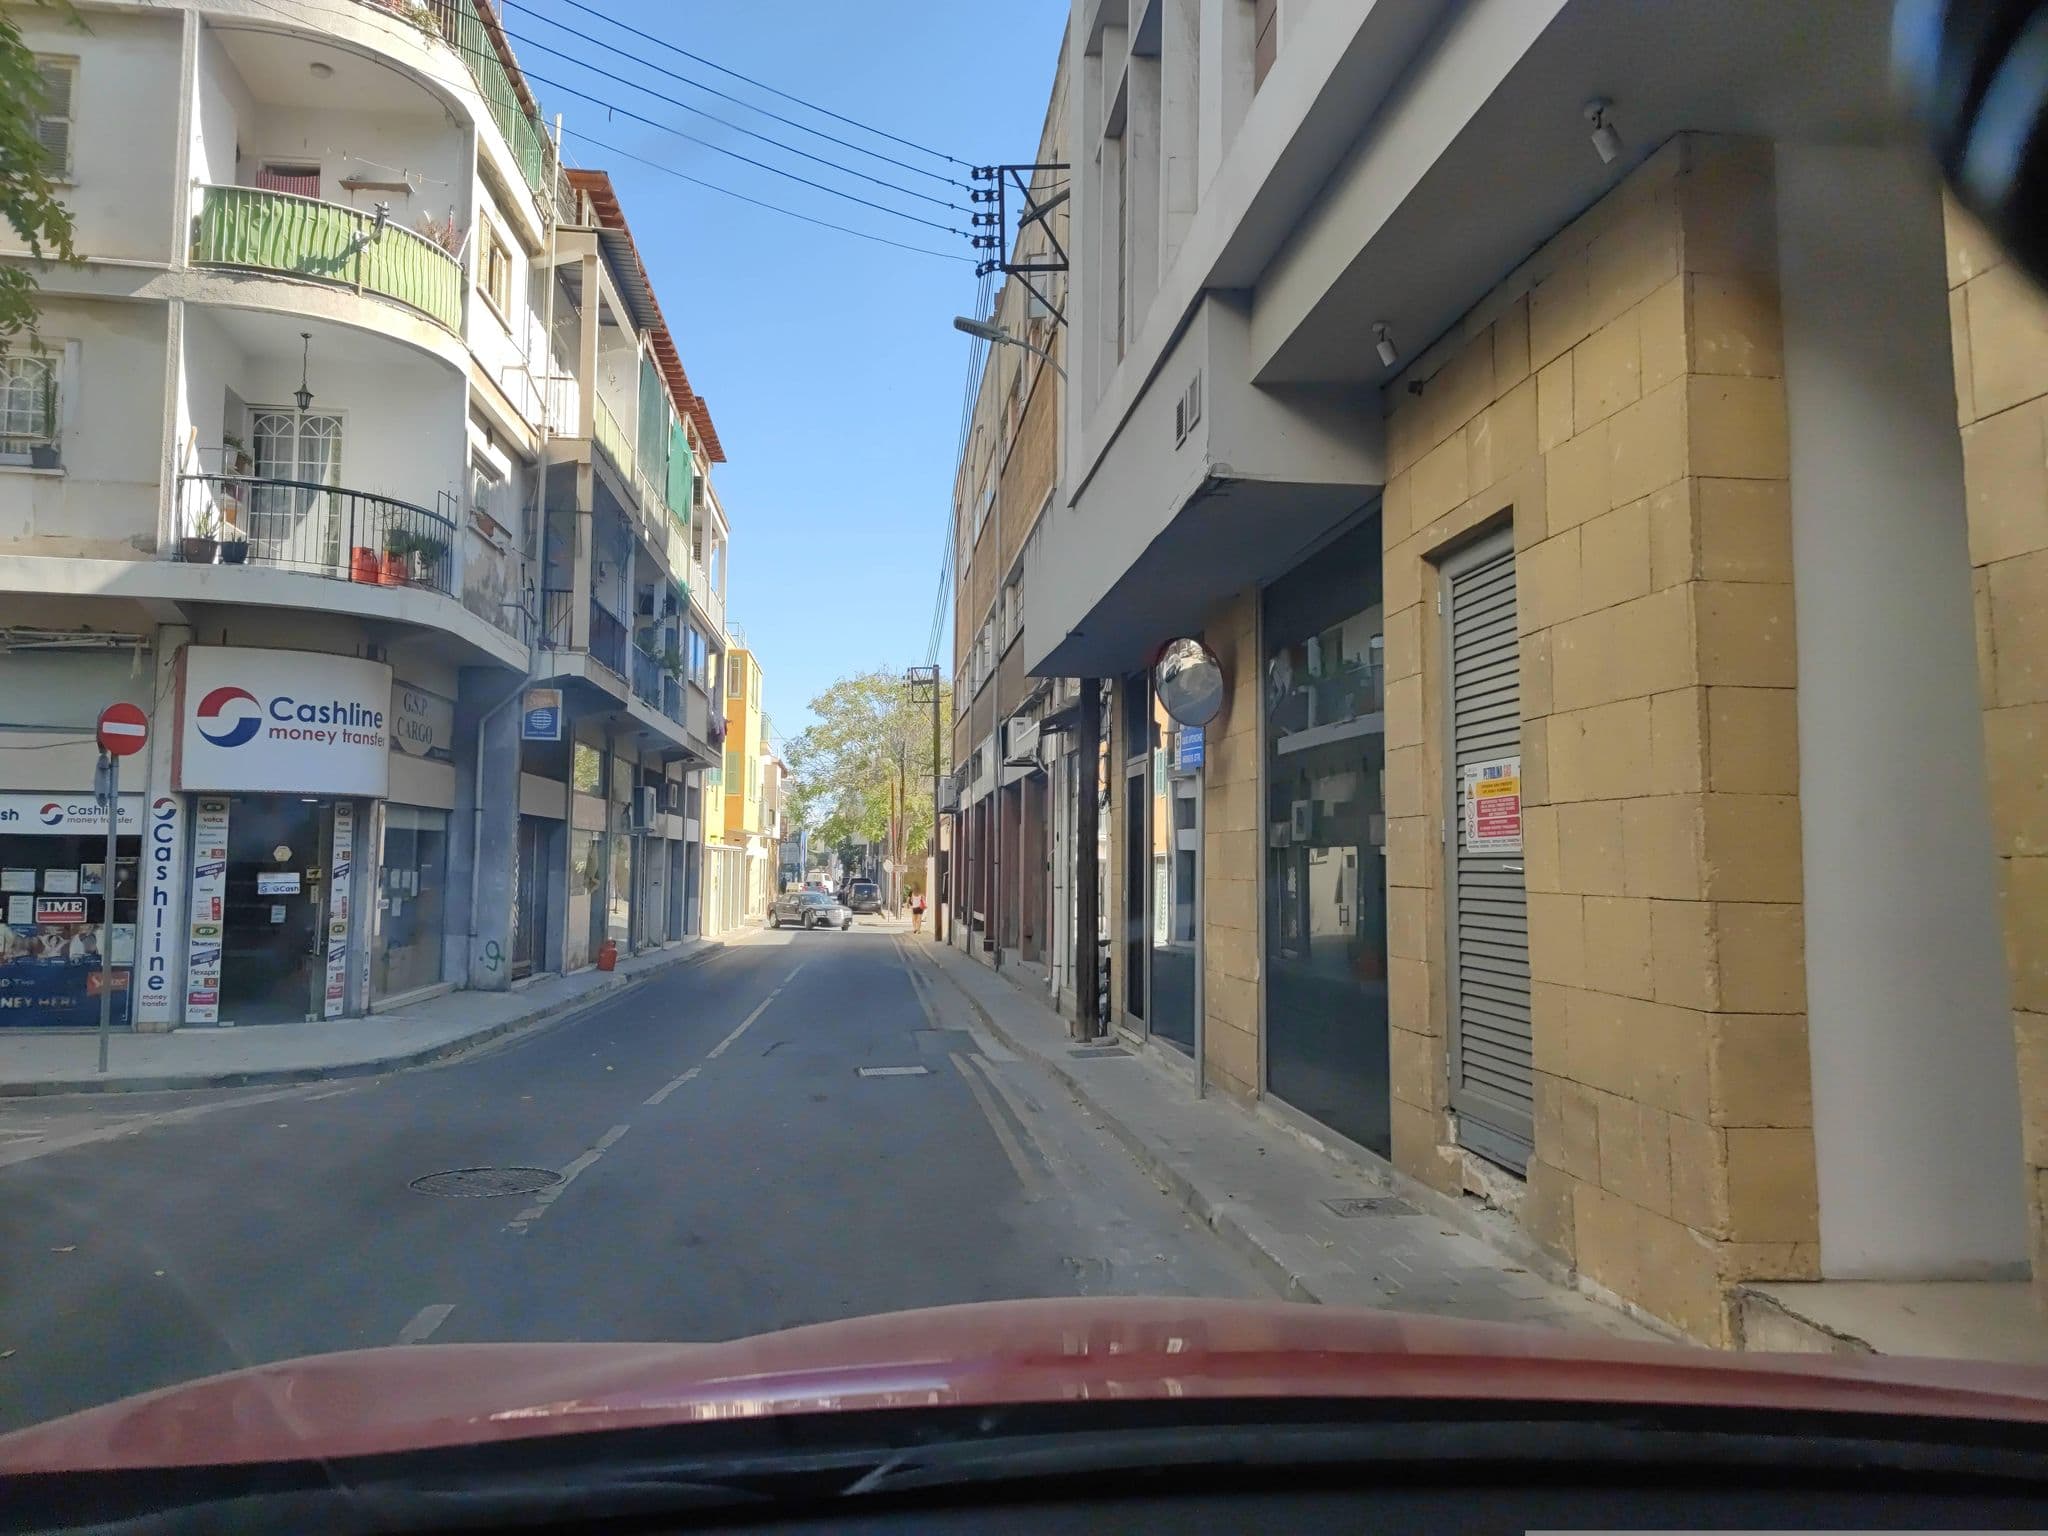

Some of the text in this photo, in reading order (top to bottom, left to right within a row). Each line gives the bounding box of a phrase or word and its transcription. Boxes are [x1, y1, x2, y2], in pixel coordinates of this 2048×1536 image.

[269, 696, 383, 729] Cashline
[268, 727, 337, 746] money
[398, 716, 432, 744] CARGO
[67, 805, 126, 816] Cashlie
[67, 817, 98, 825] money
[46, 901, 82, 913] IME
[147, 823, 174, 991] Cashline
